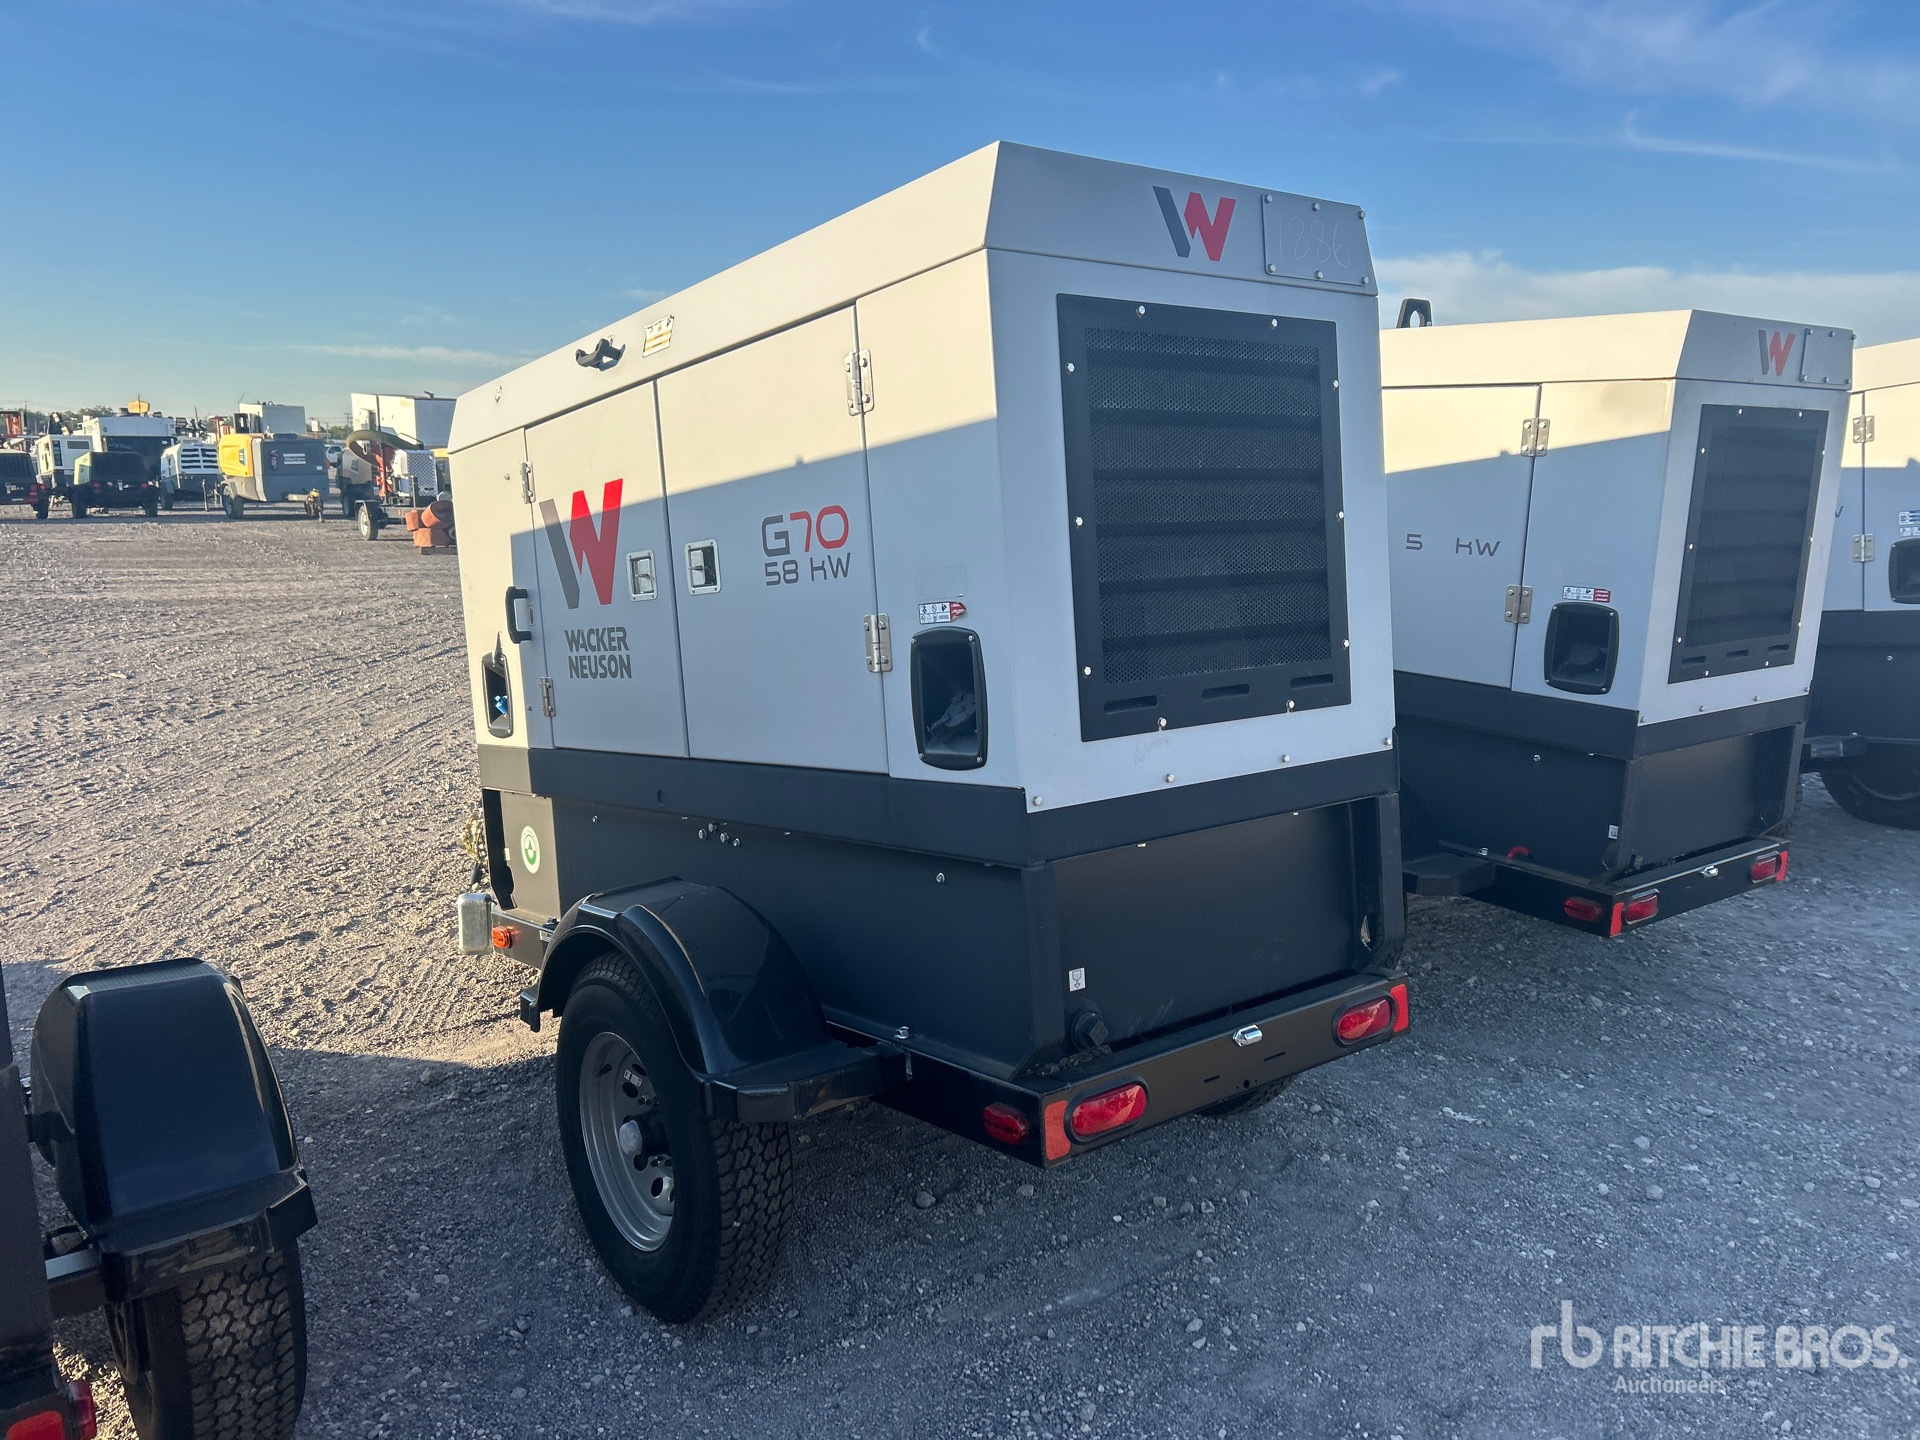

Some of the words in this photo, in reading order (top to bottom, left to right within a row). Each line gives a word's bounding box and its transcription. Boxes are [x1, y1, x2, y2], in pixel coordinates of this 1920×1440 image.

[761, 505, 849, 557] G70
[1406, 533, 1423, 551] 5
[764, 560, 799, 586] 58
[564, 626, 630, 653] WACKER
[568, 654, 633, 679] NEUSON
